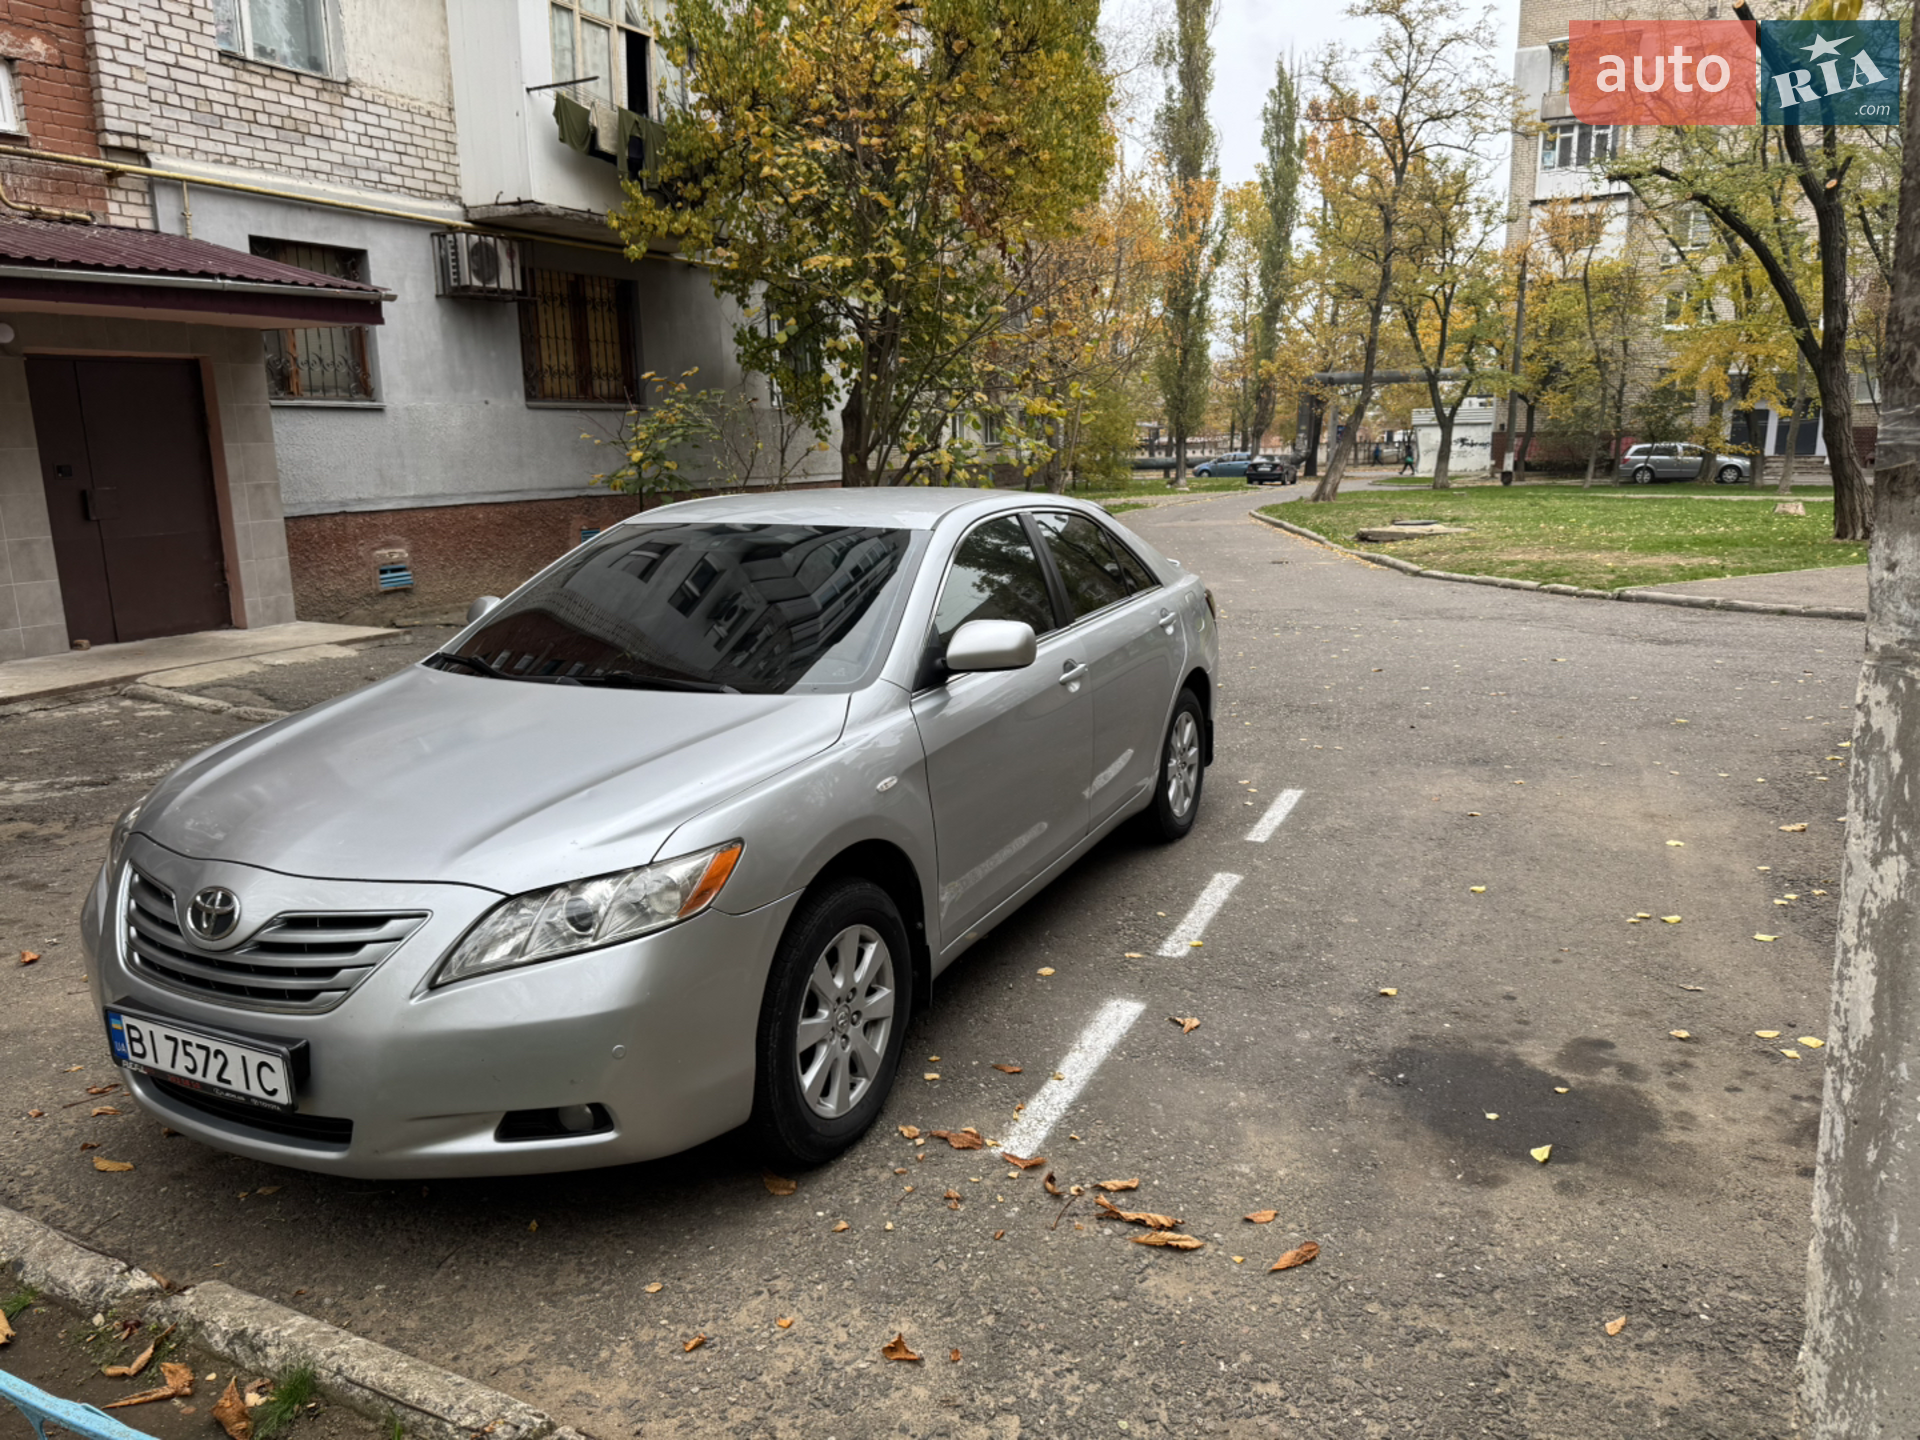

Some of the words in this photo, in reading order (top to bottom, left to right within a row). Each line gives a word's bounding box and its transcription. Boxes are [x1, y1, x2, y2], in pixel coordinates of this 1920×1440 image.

[114, 1042, 127, 1054] UA
[126, 1023, 159, 1064] BI
[164, 1034, 232, 1085] 7572
[241, 1054, 279, 1097] IC
